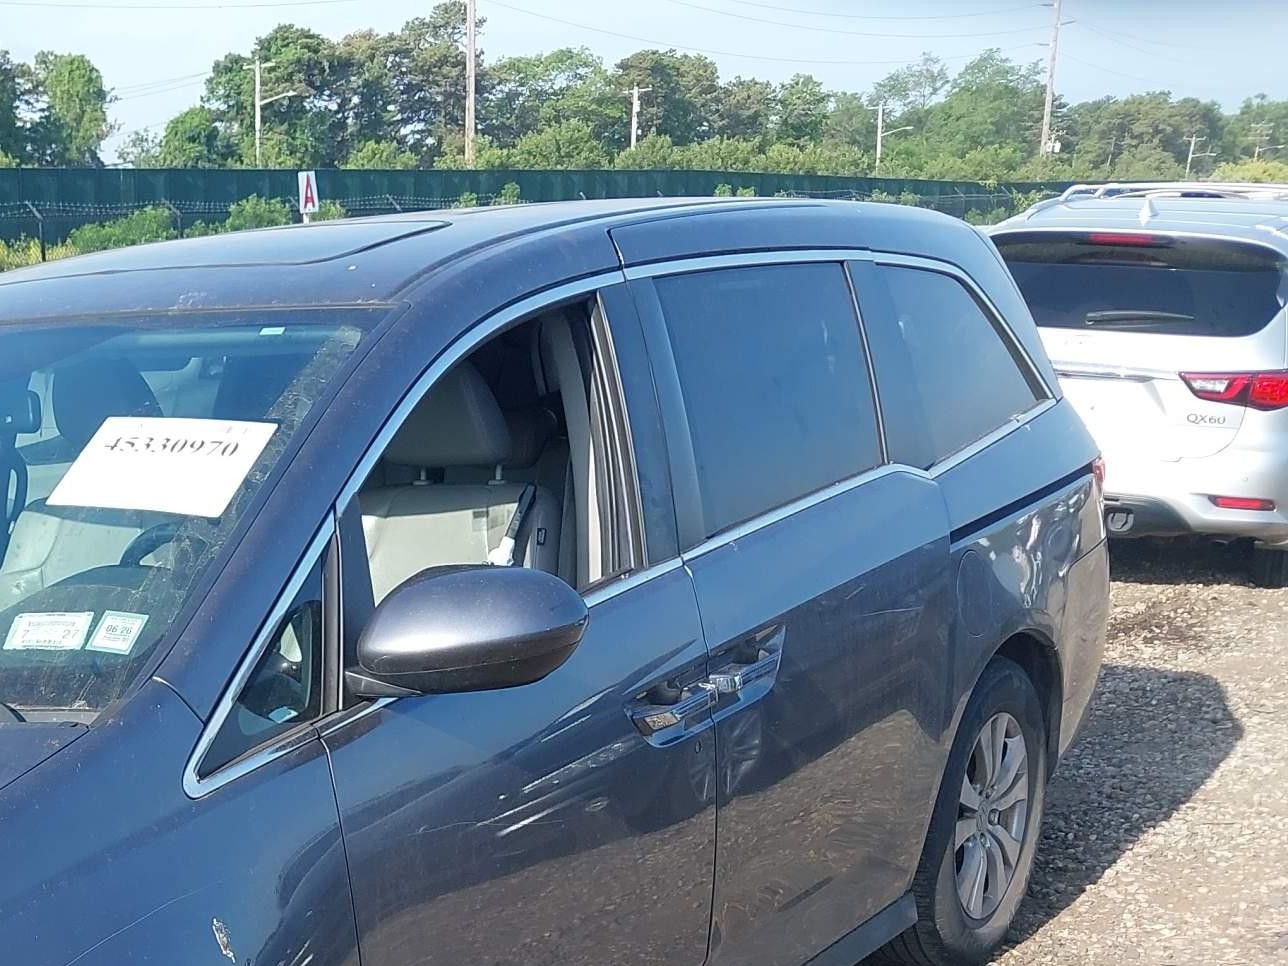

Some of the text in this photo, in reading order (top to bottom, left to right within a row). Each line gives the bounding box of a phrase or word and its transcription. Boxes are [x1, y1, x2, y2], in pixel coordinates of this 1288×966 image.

[303, 173, 316, 209] A
[1186, 413, 1226, 425] QX60
[104, 437, 240, 457] 45330970
